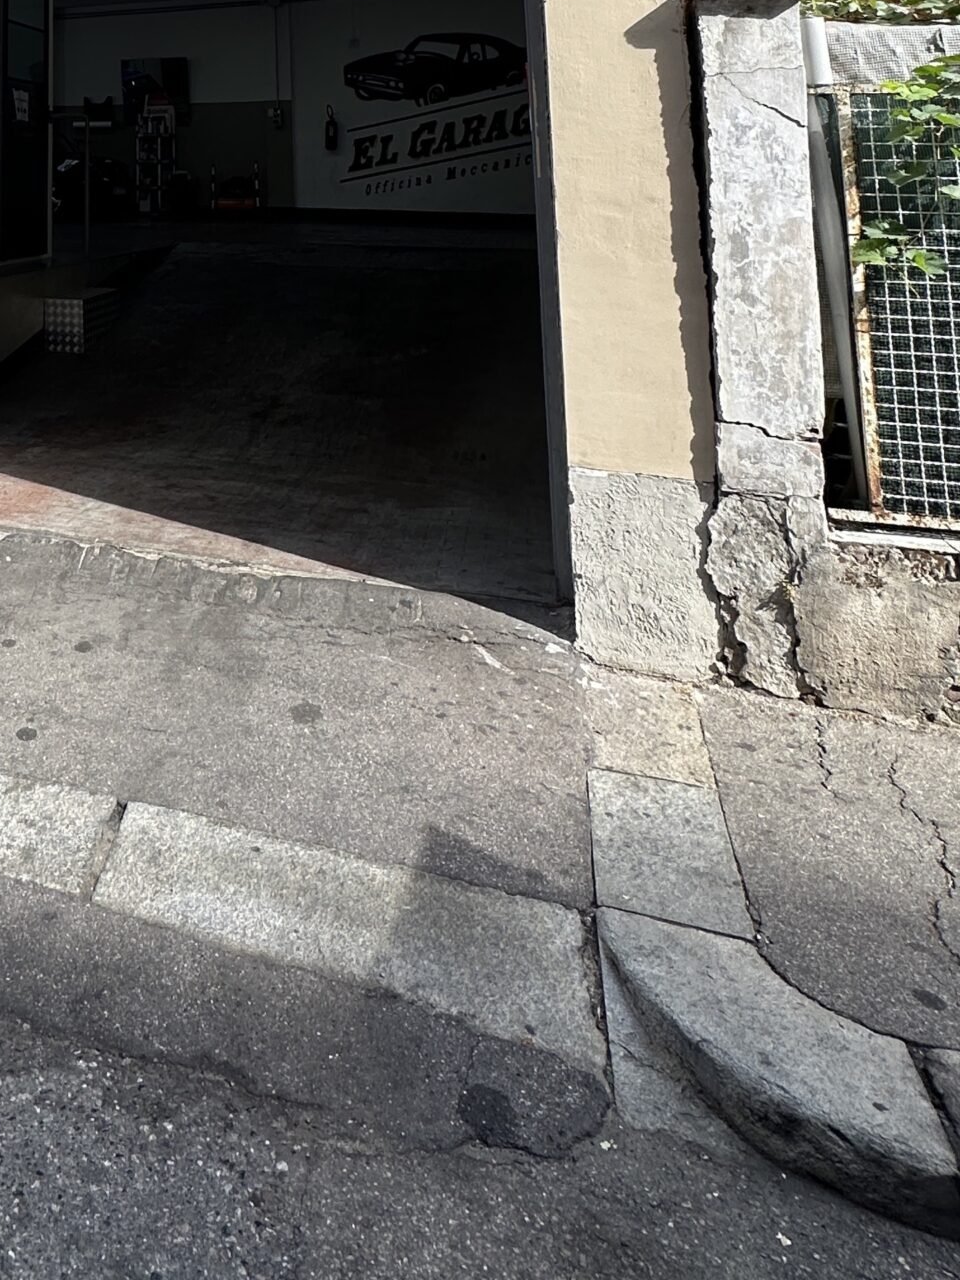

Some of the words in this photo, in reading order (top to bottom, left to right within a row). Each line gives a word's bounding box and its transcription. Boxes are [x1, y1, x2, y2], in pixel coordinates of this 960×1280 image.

[348, 134, 399, 172] EL
[408, 104, 530, 158] GARAG
[365, 175, 432, 195] Officina
[447, 152, 531, 180] Meccanic
